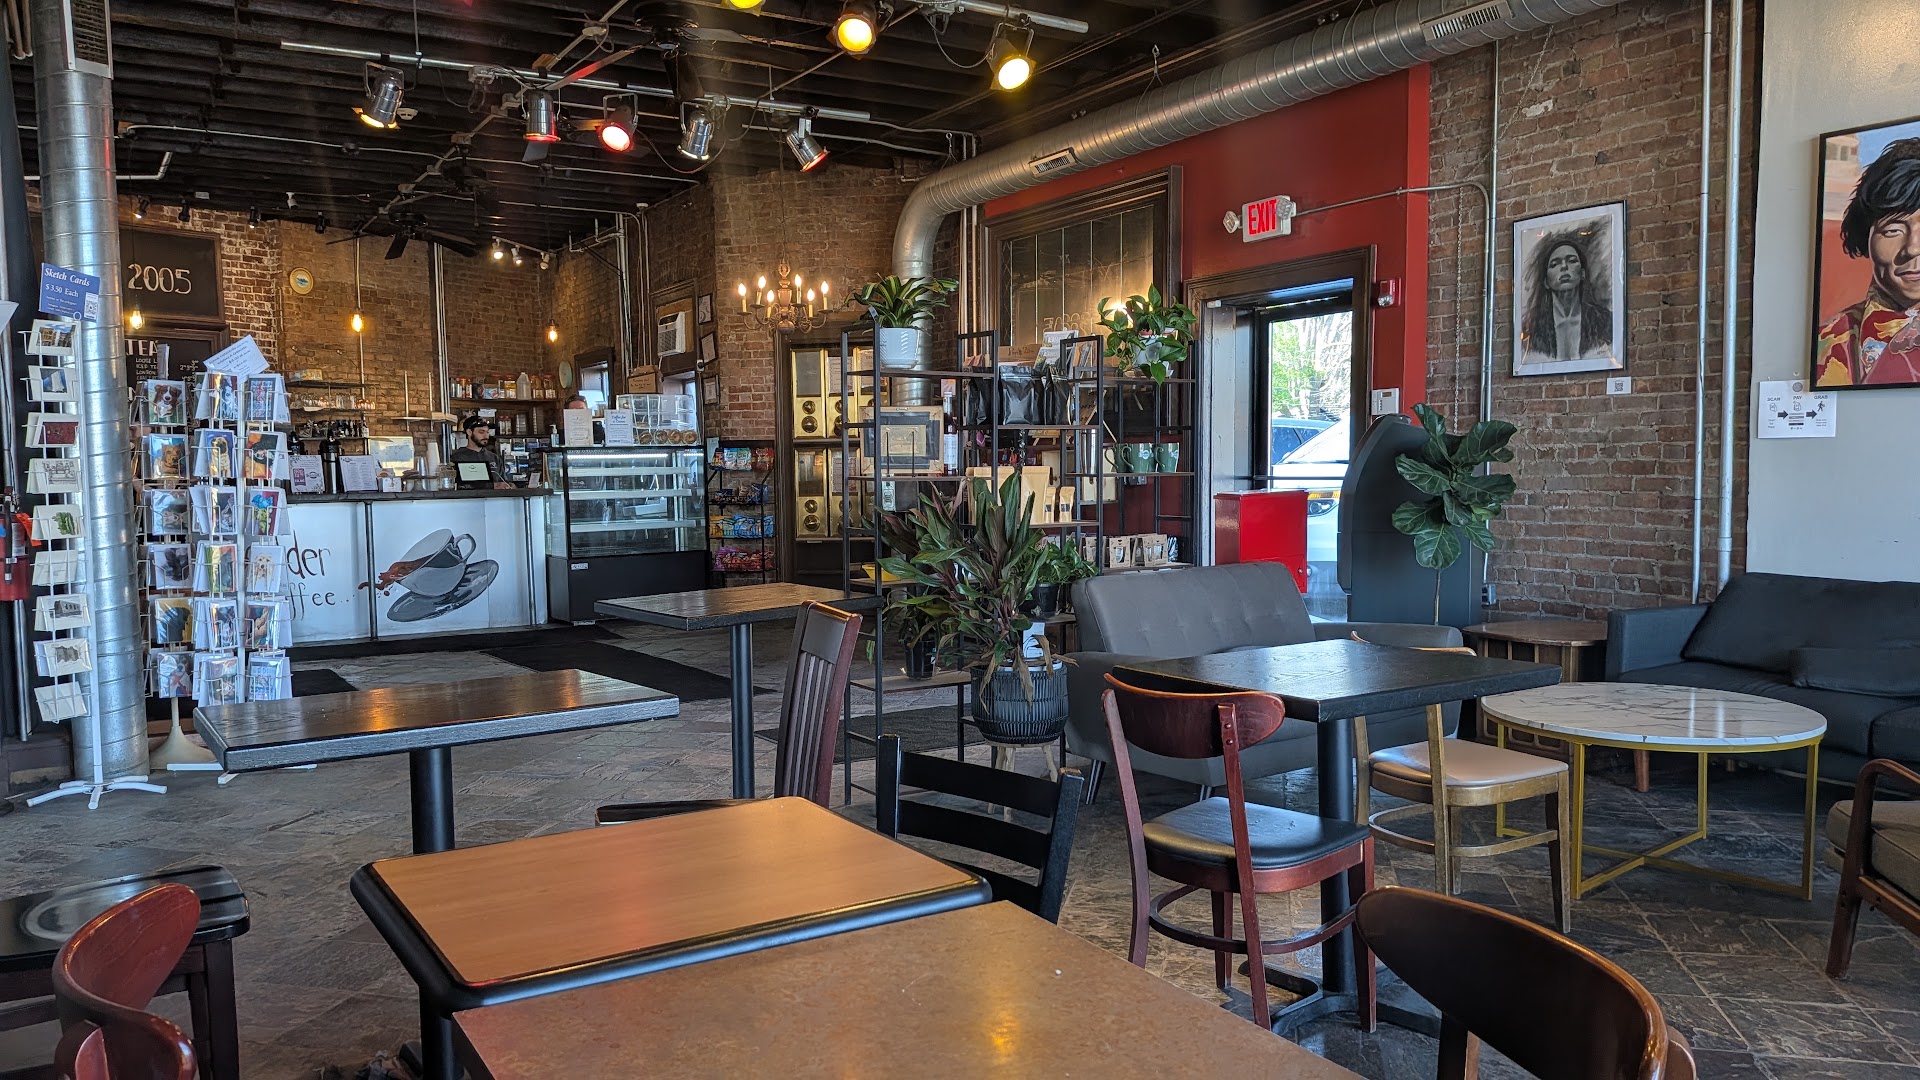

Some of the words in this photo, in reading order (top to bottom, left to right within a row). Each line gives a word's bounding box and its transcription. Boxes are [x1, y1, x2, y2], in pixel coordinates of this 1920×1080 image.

[1248, 199, 1277, 234] EXIT
[44, 267, 67, 281] Sketch
[69, 274, 90, 287] Cards
[128, 263, 192, 294] 2005
[50, 284, 63, 294] 3.50
[64, 287, 79, 298] Each
